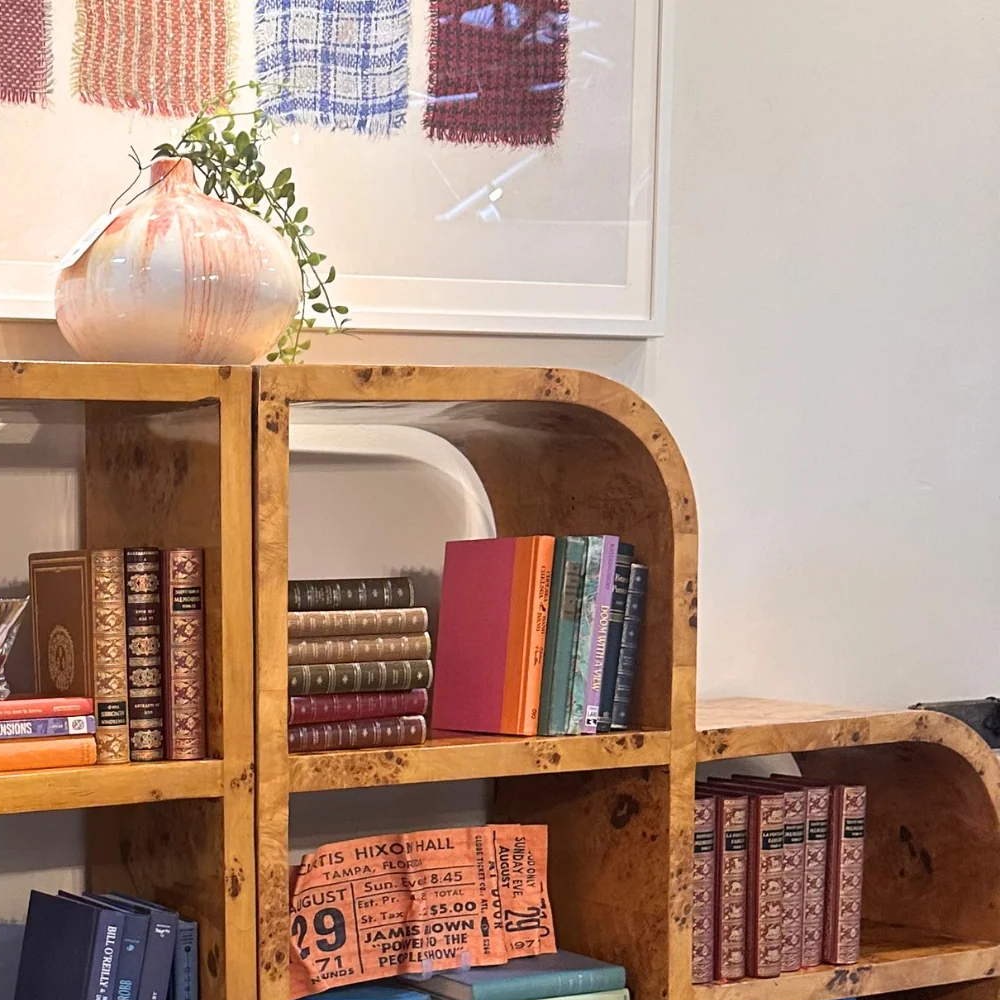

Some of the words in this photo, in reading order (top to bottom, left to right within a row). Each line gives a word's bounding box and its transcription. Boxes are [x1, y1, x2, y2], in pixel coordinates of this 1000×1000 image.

[600, 605, 610, 634] DOOM
[596, 635, 607, 659] WITH
[592, 669, 602, 692] VIEW
[416, 838, 455, 853] HALL
[513, 837, 526, 874] SUNDAY
[323, 864, 377, 881] TAMPA,
[477, 857, 486, 882] TICKET
[499, 845, 511, 889] AUGUST
[526, 865, 537, 888] ONLY
[364, 881, 399, 893] Sun.
[430, 871, 463, 885] 8:45
[434, 889, 465, 899] TOTAL
[380, 909, 405, 920] Tax
[430, 901, 477, 917] $5.00
[106, 925, 117, 947] BILL
[291, 907, 347, 961] 29
[363, 925, 421, 944] JAMES
[444, 933, 468, 946] THE
[99, 947, 114, 988] O'REILLY
[378, 950, 424, 968] PEOPLE
